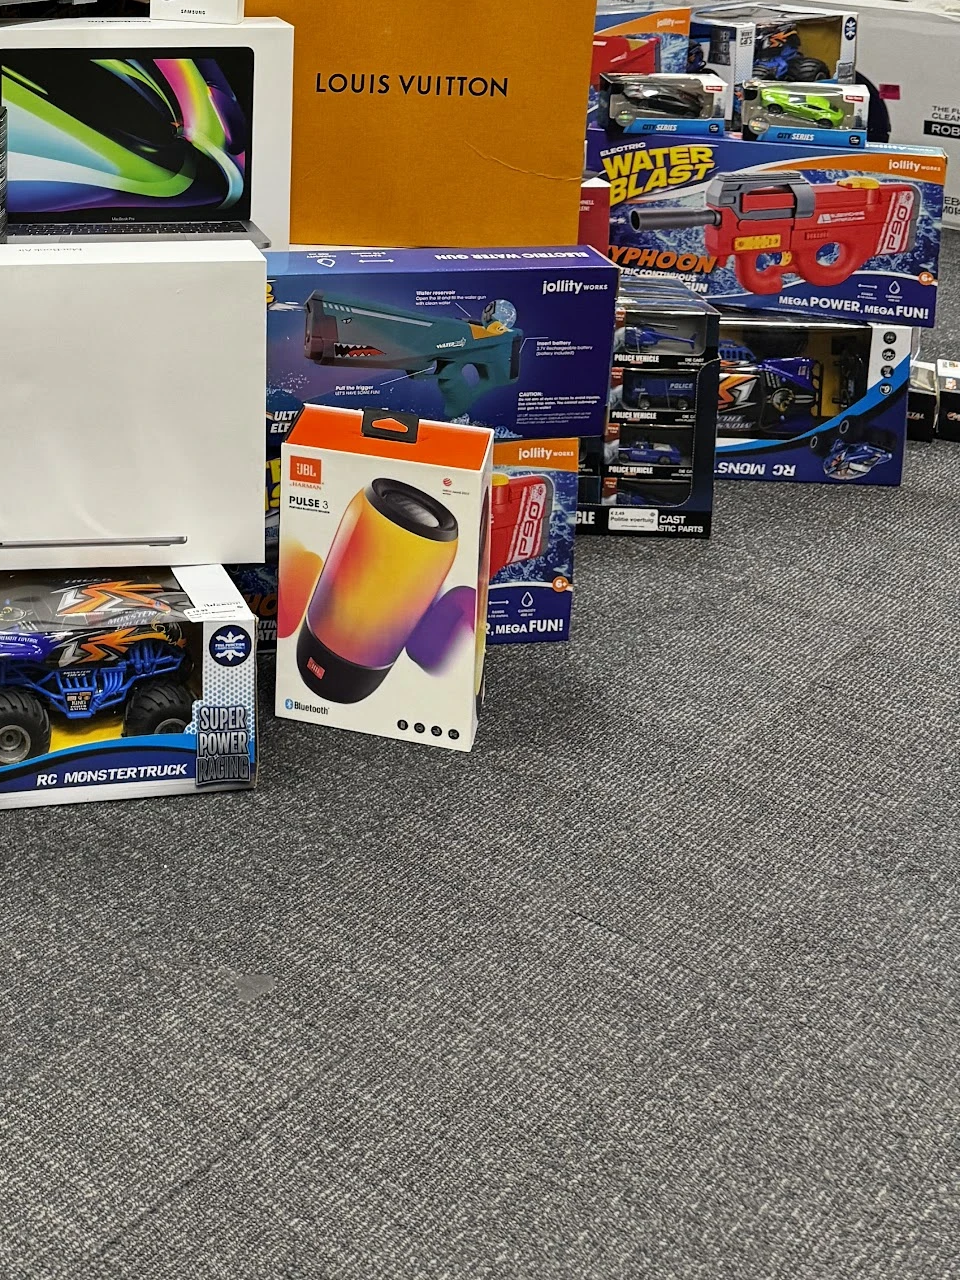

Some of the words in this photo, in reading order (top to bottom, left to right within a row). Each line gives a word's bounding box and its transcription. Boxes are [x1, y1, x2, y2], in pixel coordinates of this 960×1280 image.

[316, 72, 390, 94] LOUIS
[398, 75, 508, 98] VUITTON
[932, 105, 949, 113] THE
[656, 124, 678, 132] SERIES
[792, 133, 815, 141] SERIES
[600, 142, 646, 157] ELECTRIC
[602, 146, 715, 180] WATER
[888, 159, 921, 172] jollity
[609, 162, 715, 207] BLAST
[471, 252, 520, 260] WATER
[523, 251, 590, 259] ELECTRIC
[610, 245, 717, 273] YPHOON
[921, 274, 933, 282] 6+
[542, 279, 584, 295] jollity
[779, 295, 809, 306] MEGA
[810, 296, 864, 313] POWER,
[864, 304, 895, 316] MEGA
[896, 305, 929, 319] FUN!
[614, 354, 635, 363] POLICE
[636, 354, 660, 363] VEHICLE
[612, 411, 632, 419] POLICE
[518, 448, 553, 461] jollity
[296, 462, 317, 477] JBL
[608, 466, 629, 474] POLICE
[630, 466, 654, 474] VEHICLE
[772, 463, 796, 477] RC
[292, 481, 322, 490] HARMAN
[289, 495, 320, 508] PULSE
[322, 500, 329, 510] 3
[659, 515, 686, 524] CAST
[555, 580, 567, 588] 6+
[495, 624, 528, 634] MEGA
[529, 618, 564, 633] FUN!
[294, 701, 328, 715] Bluetooth
[199, 706, 246, 731] SUPER
[198, 731, 249, 756] POWER
[37, 773, 57, 786] RC
[64, 763, 189, 784] MONSTERTRUCK
[197, 755, 250, 782] RACING
